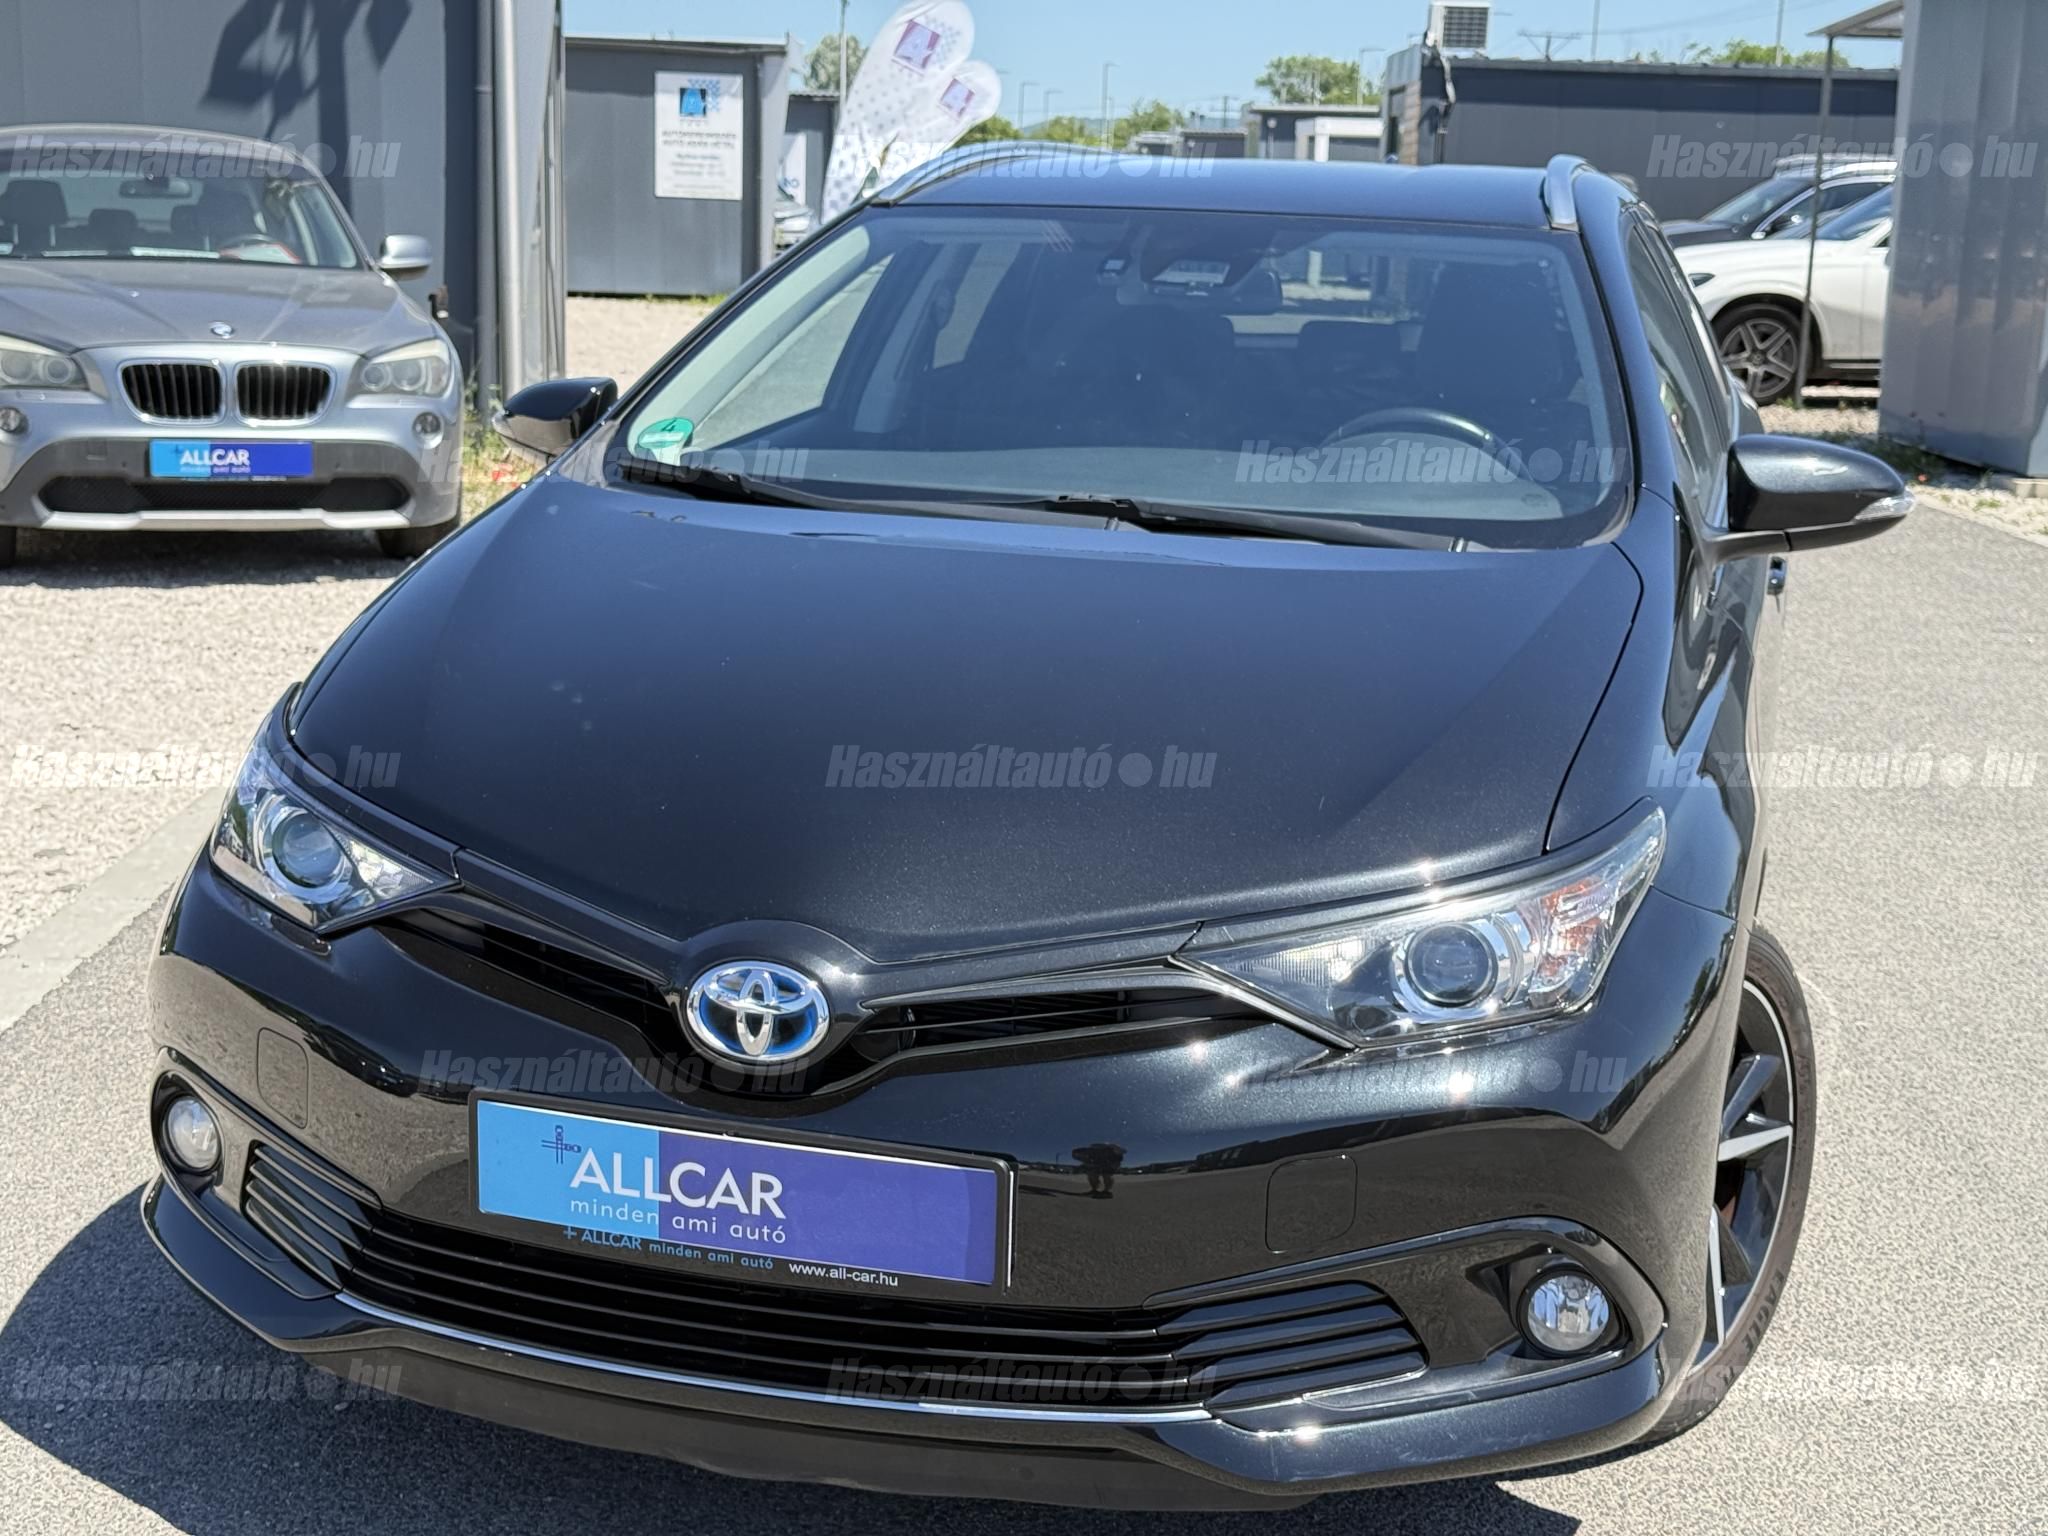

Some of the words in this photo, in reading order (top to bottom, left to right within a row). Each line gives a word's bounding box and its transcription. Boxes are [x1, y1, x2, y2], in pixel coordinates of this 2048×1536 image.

[661, 418, 676, 432] 4
[180, 448, 251, 466] ALLCAR
[569, 1146, 786, 1220] ALLCAR
[570, 1198, 659, 1226] minden
[671, 1215, 717, 1235] ami
[729, 1220, 786, 1245] autó
[581, 1229, 641, 1251] ALLCAR
[649, 1242, 702, 1260] minden
[708, 1250, 734, 1265] ami
[741, 1253, 774, 1270] autó
[788, 1261, 899, 1288] www.all-car.hu
